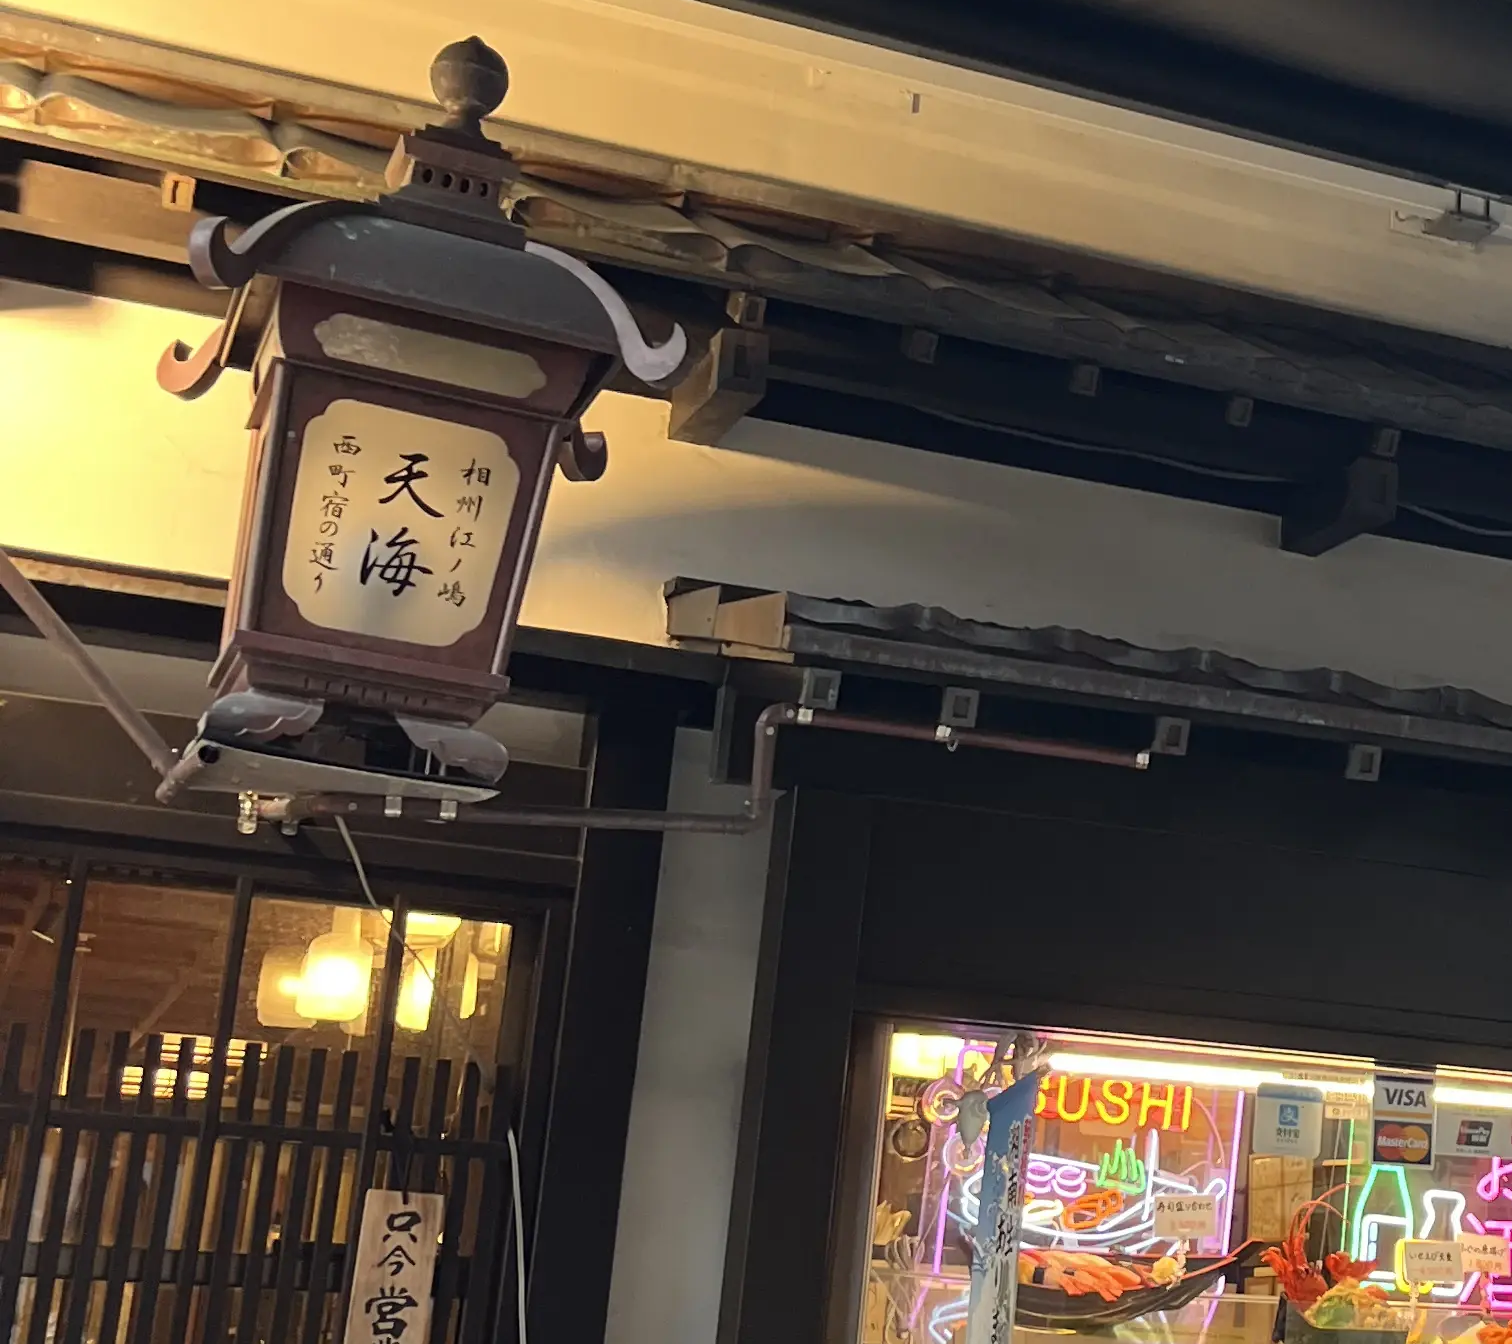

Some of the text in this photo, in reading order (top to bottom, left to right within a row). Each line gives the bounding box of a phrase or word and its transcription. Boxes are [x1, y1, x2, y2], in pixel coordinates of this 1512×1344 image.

[359, 452, 445, 598] 天海
[1382, 1087, 1428, 1109] VISA
[1376, 1135, 1429, 1151] MasterCard
